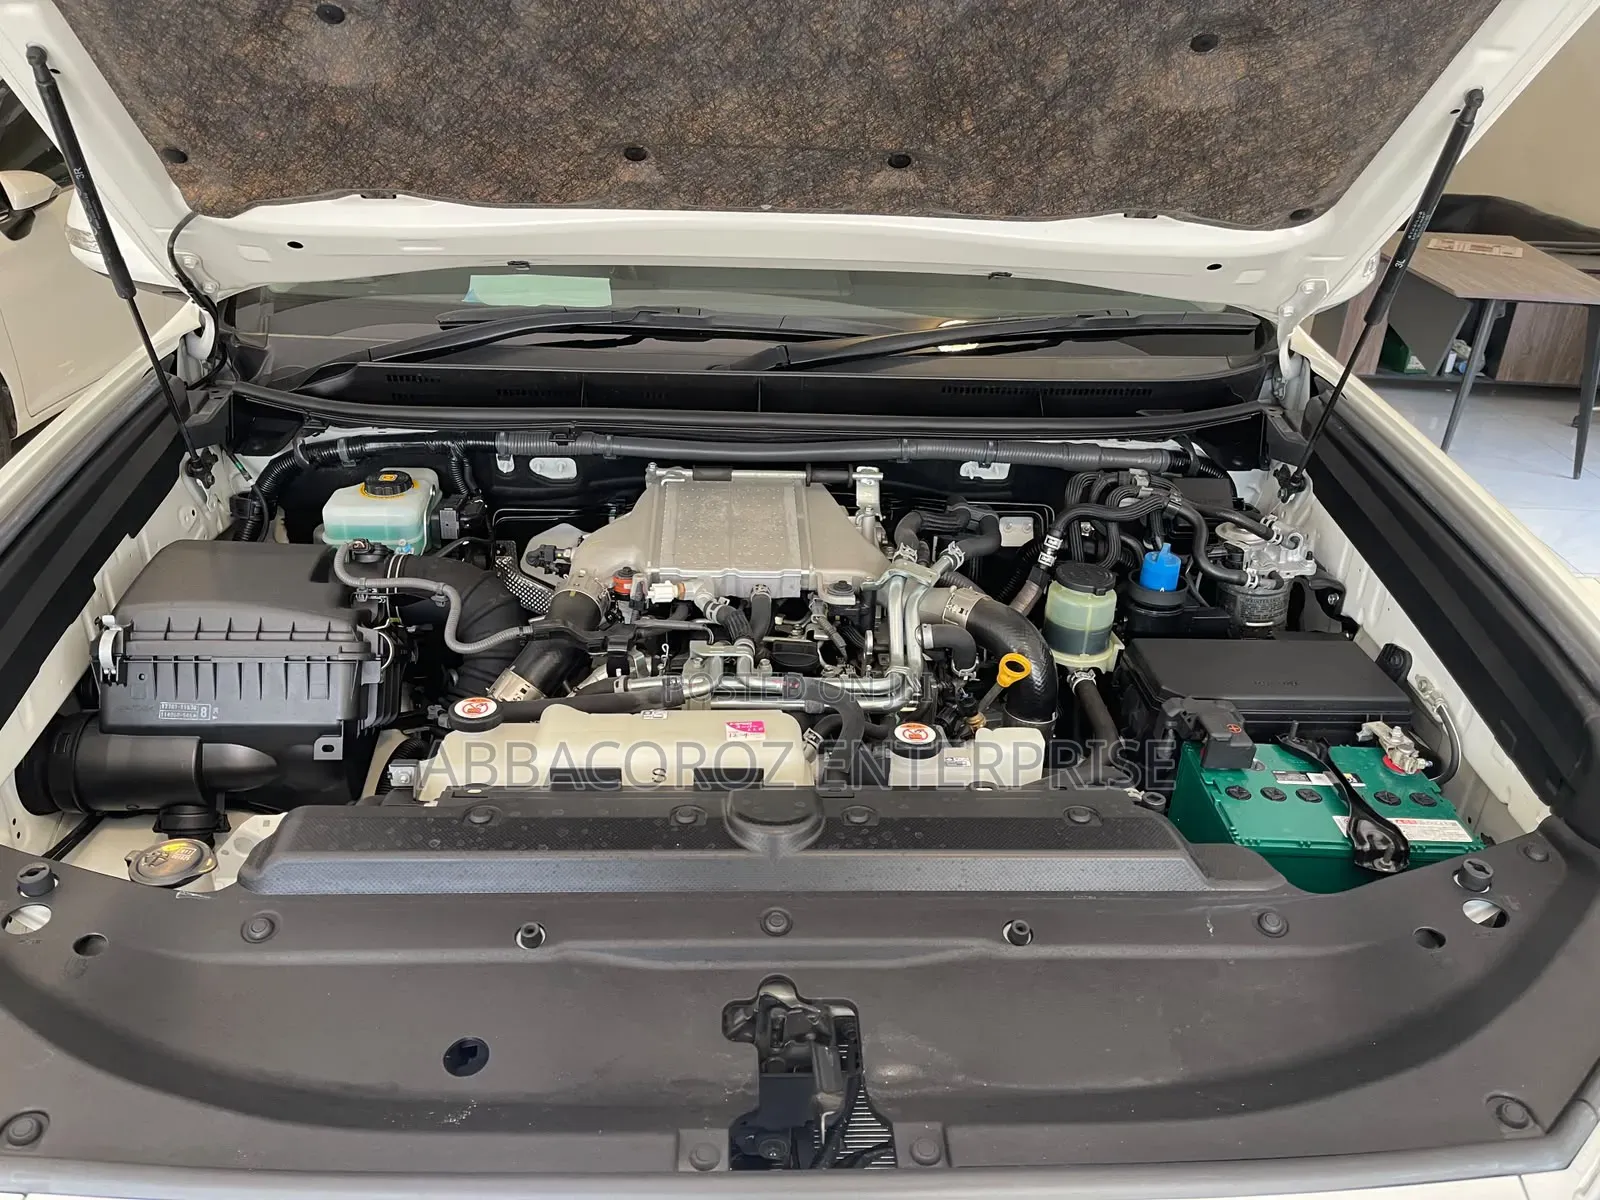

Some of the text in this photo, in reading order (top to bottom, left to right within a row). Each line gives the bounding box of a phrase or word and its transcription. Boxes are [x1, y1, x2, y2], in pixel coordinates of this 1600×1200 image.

[73, 166, 85, 180] 3R
[1394, 258, 1406, 269] 3L
[200, 706, 208, 719] 8
